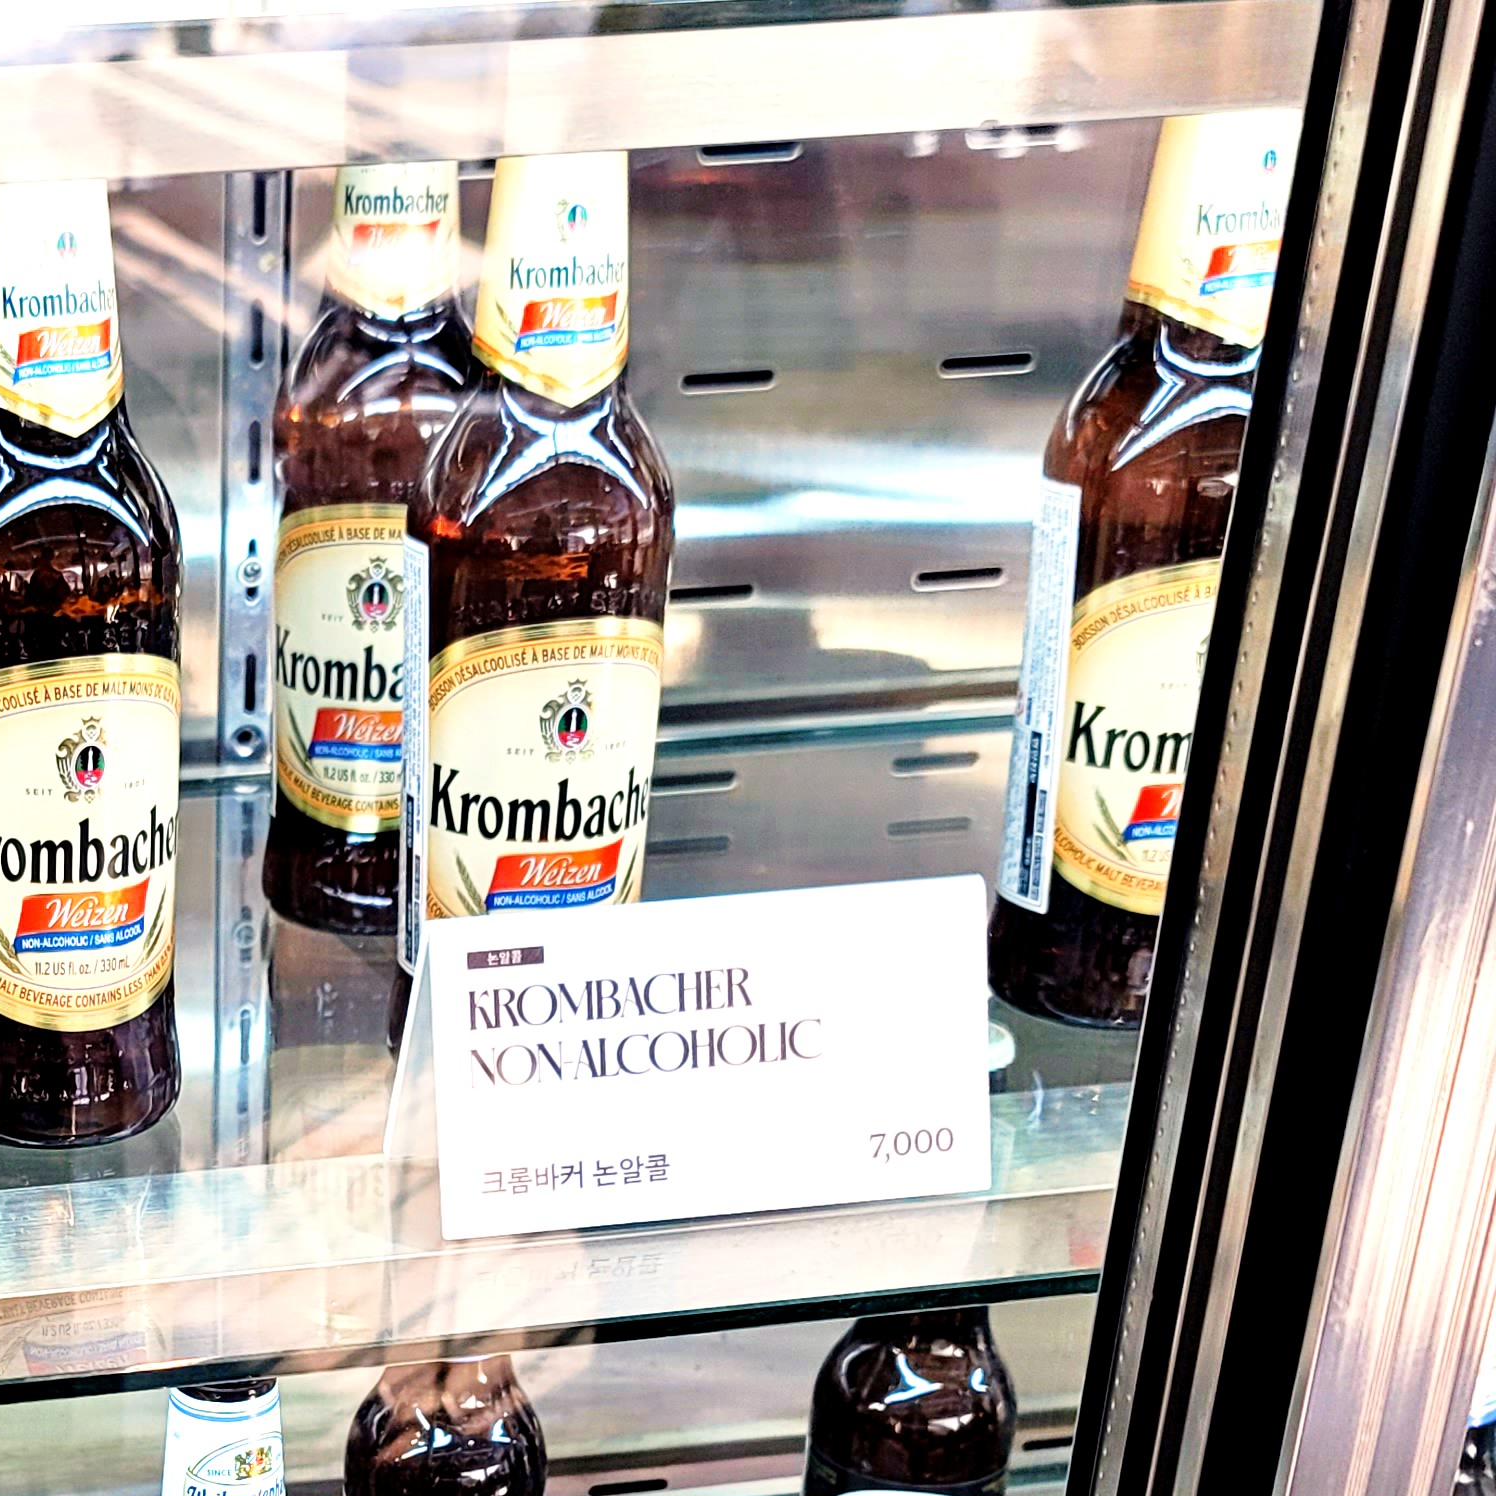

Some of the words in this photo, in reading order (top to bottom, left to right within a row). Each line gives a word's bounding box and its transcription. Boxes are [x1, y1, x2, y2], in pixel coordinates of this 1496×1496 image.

[344, 182, 448, 216] Krombacher
[510, 252, 624, 290] Krombacher
[540, 301, 606, 328] Weizen
[276, 624, 403, 701] Kromba
[453, 648, 529, 686] DÉSALCOOLISÉ
[542, 646, 571, 664] BASE
[573, 645, 587, 660] DE
[589, 644, 615, 659] MALT
[54, 683, 82, 701] BASE
[85, 681, 100, 698] DE
[102, 680, 129, 696] MALT
[430, 762, 651, 844] Krombache
[519, 854, 602, 887] Weizen
[45, 897, 130, 928] Weizen
[22, 935, 88, 949] NON-ALCOHOLIC
[95, 931, 114, 946] SANS
[115, 924, 142, 943] ALCOOL
[34, 961, 51, 975] 11.2
[52, 961, 67, 975] US
[79, 964, 92, 975] oz.
[100, 959, 117, 974] 330
[487, 950, 522, 966] 논알콜
[468, 967, 753, 1032] KROMBACHER
[471, 1018, 824, 1090] NON-ALCOHOLIC
[869, 1126, 955, 1164] 7,000
[482, 1157, 585, 1196] 크롬바커
[592, 1152, 671, 1188] 논알콜
